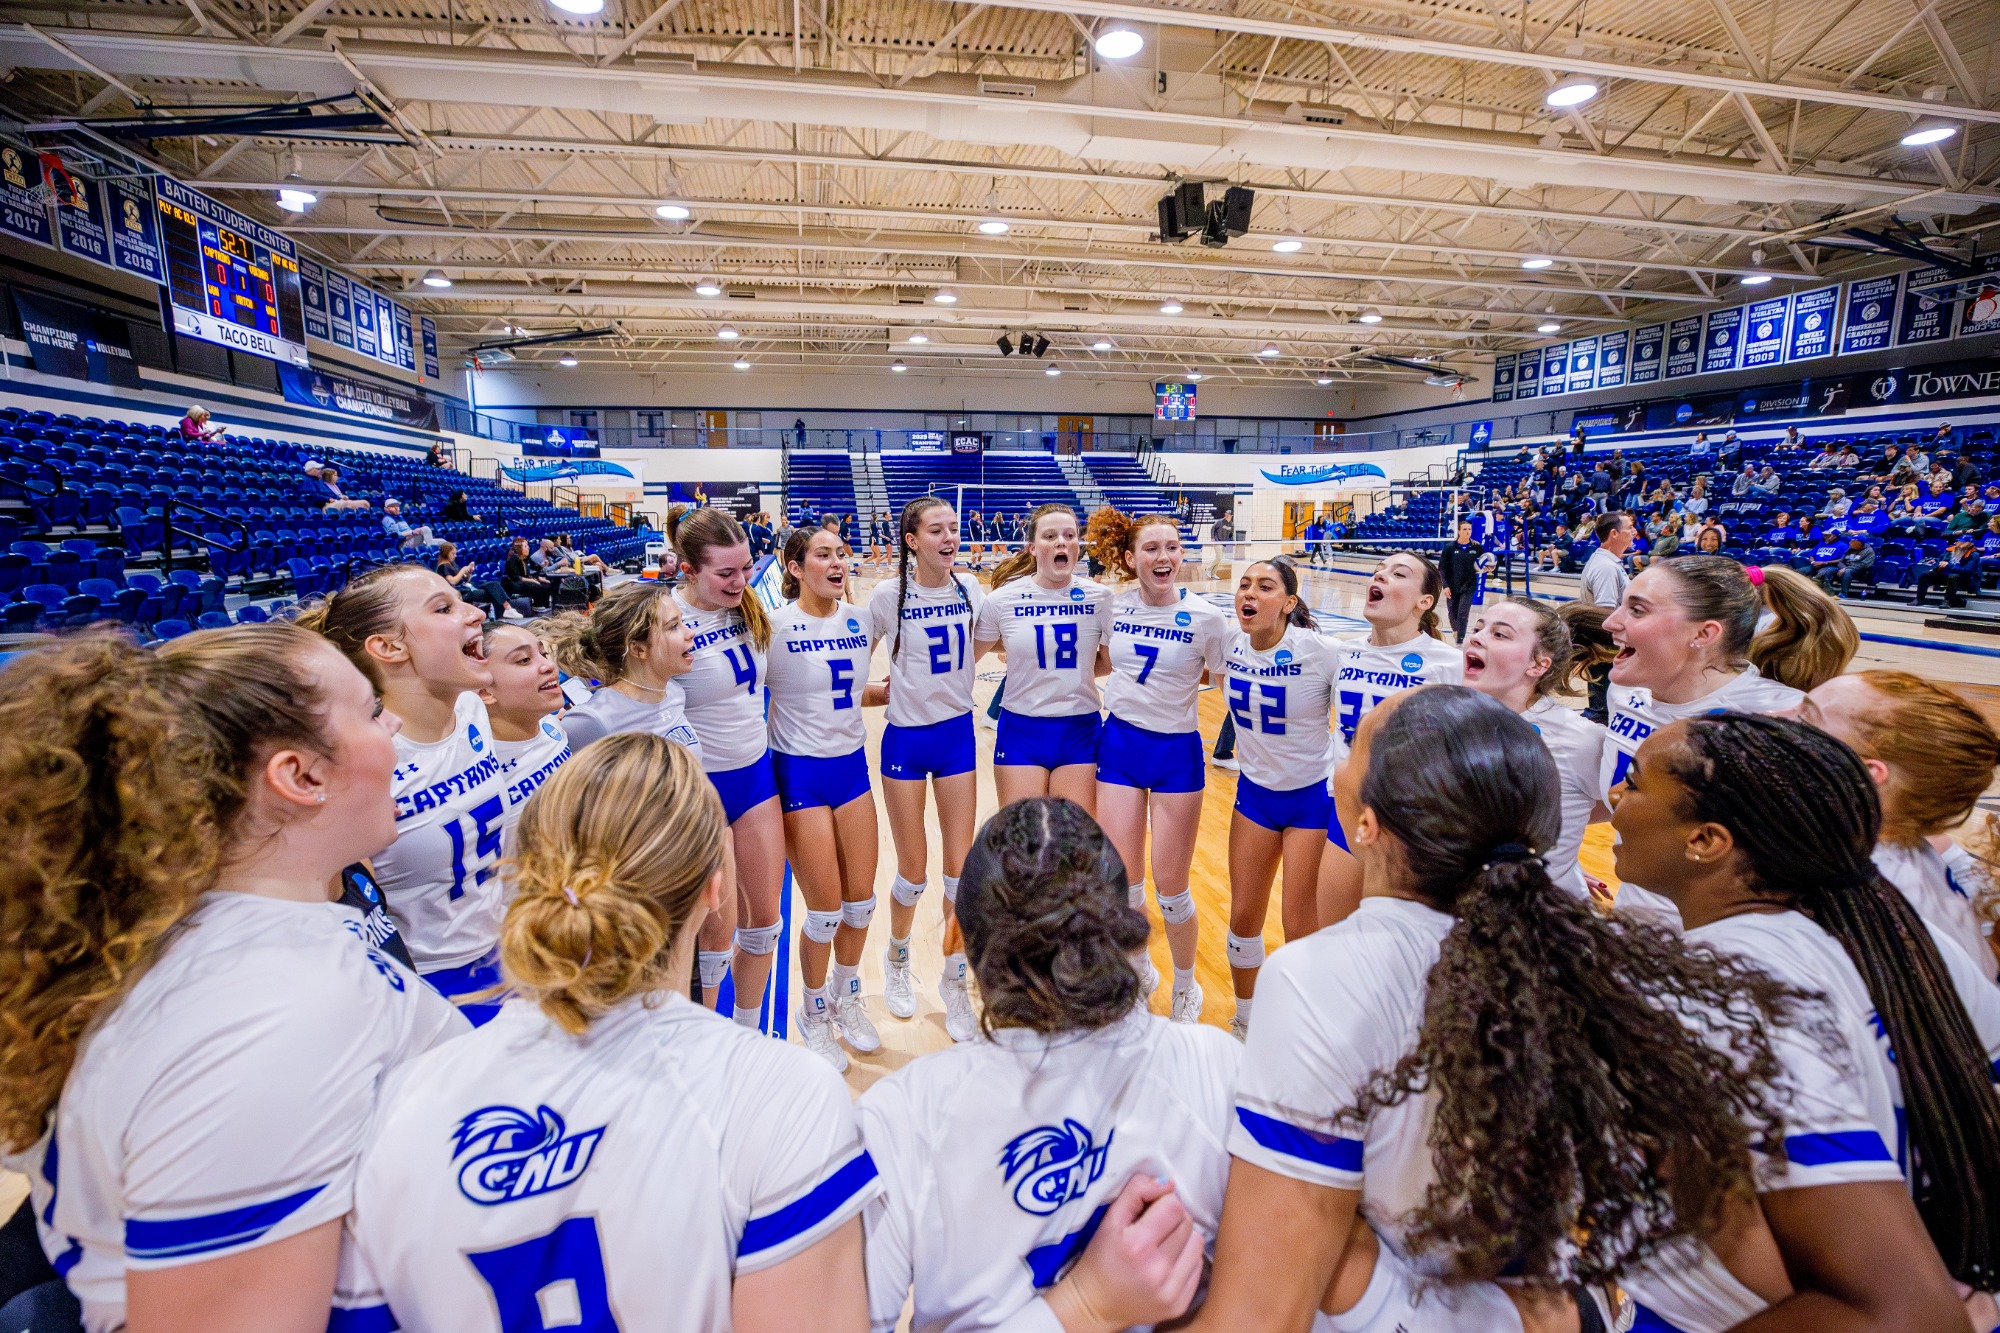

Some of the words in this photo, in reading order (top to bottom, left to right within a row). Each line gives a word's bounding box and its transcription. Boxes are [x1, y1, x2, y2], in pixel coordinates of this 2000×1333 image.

[4, 208, 40, 234] 2017
[164, 179, 209, 215] BATTEN
[211, 203, 256, 238] STUDENT
[258, 227, 291, 254] CENTER
[70, 231, 102, 255] 2018
[219, 229, 248, 258] 52.7
[123, 250, 154, 272] 2019
[203, 245, 231, 265] CAPTAINS
[217, 264, 227, 285] 0
[248, 265, 269, 281] VIKINGS
[1915, 268, 1949, 279] VIRGIN
[265, 283, 274, 303] 0
[1852, 284, 1896, 299] WESLEYAN
[1858, 278, 1892, 291] VIRGINIA
[235, 294, 254, 309] MATCH
[1797, 296, 1836, 310] WESLEYAN
[1801, 290, 1832, 302] VIRGINIA
[213, 299, 221, 316] 0
[1750, 306, 1785, 319] WESLEYAN
[1754, 301, 1782, 312] VIRGINIA
[1913, 318, 1938, 329] EIGHT
[1914, 311, 1939, 321] ELITE
[23, 321, 78, 342] CHAMPIONS
[270, 319, 278, 335] 0
[1798, 329, 1825, 340] SWEET
[1846, 326, 1889, 339] CHAMPIONS
[1847, 320, 1890, 332] CONFERENCE
[1906, 326, 1941, 341] 2012
[30, 332, 50, 345] WIN
[51, 339, 76, 351] HERE
[217, 325, 248, 347] TACO
[250, 338, 276, 355] BELL
[1795, 336, 1826, 347] SIXTEEN
[1850, 335, 1882, 349] 2012
[95, 342, 132, 360] VOLLEYBALL
[1748, 351, 1775, 364] 2009
[1796, 344, 1823, 357] 2011
[1706, 358, 1731, 370] 2007
[333, 382, 355, 398] NCAA
[372, 392, 411, 413] VOLLEYBALL
[1759, 396, 1800, 409] DIVISION
[1801, 396, 1810, 405] III
[335, 396, 393, 419] CHAMPIONSHIP
[1576, 417, 1613, 429] CHAMPIONS
[955, 438, 978, 446] ECAC
[513, 457, 536, 471] FEAR
[538, 459, 557, 471] THE
[581, 461, 607, 475] FISH
[1280, 464, 1306, 478] FEAR
[1309, 465, 1329, 476] THE
[1348, 463, 1369, 478] FISH
[901, 602, 972, 620] CAPTAINS
[1014, 603, 1096, 618] CAPTAINS
[1113, 621, 1196, 645] CAPTAINS
[786, 634, 868, 653] CAPTAINS
[923, 622, 966, 675] 21
[1034, 622, 1078, 670] 18
[722, 643, 757, 696] 4
[1133, 643, 1160, 686] 7
[1403, 660, 1422, 669] NCAA
[826, 658, 855, 711] 5
[1338, 666, 1427, 689] CAPTAINS
[1229, 676, 1287, 735] 22
[1610, 712, 1658, 742] CAP
[507, 743, 572, 807] CAPTAIN
[395, 749, 500, 822] CAPTAINS
[443, 793, 505, 902] 15
